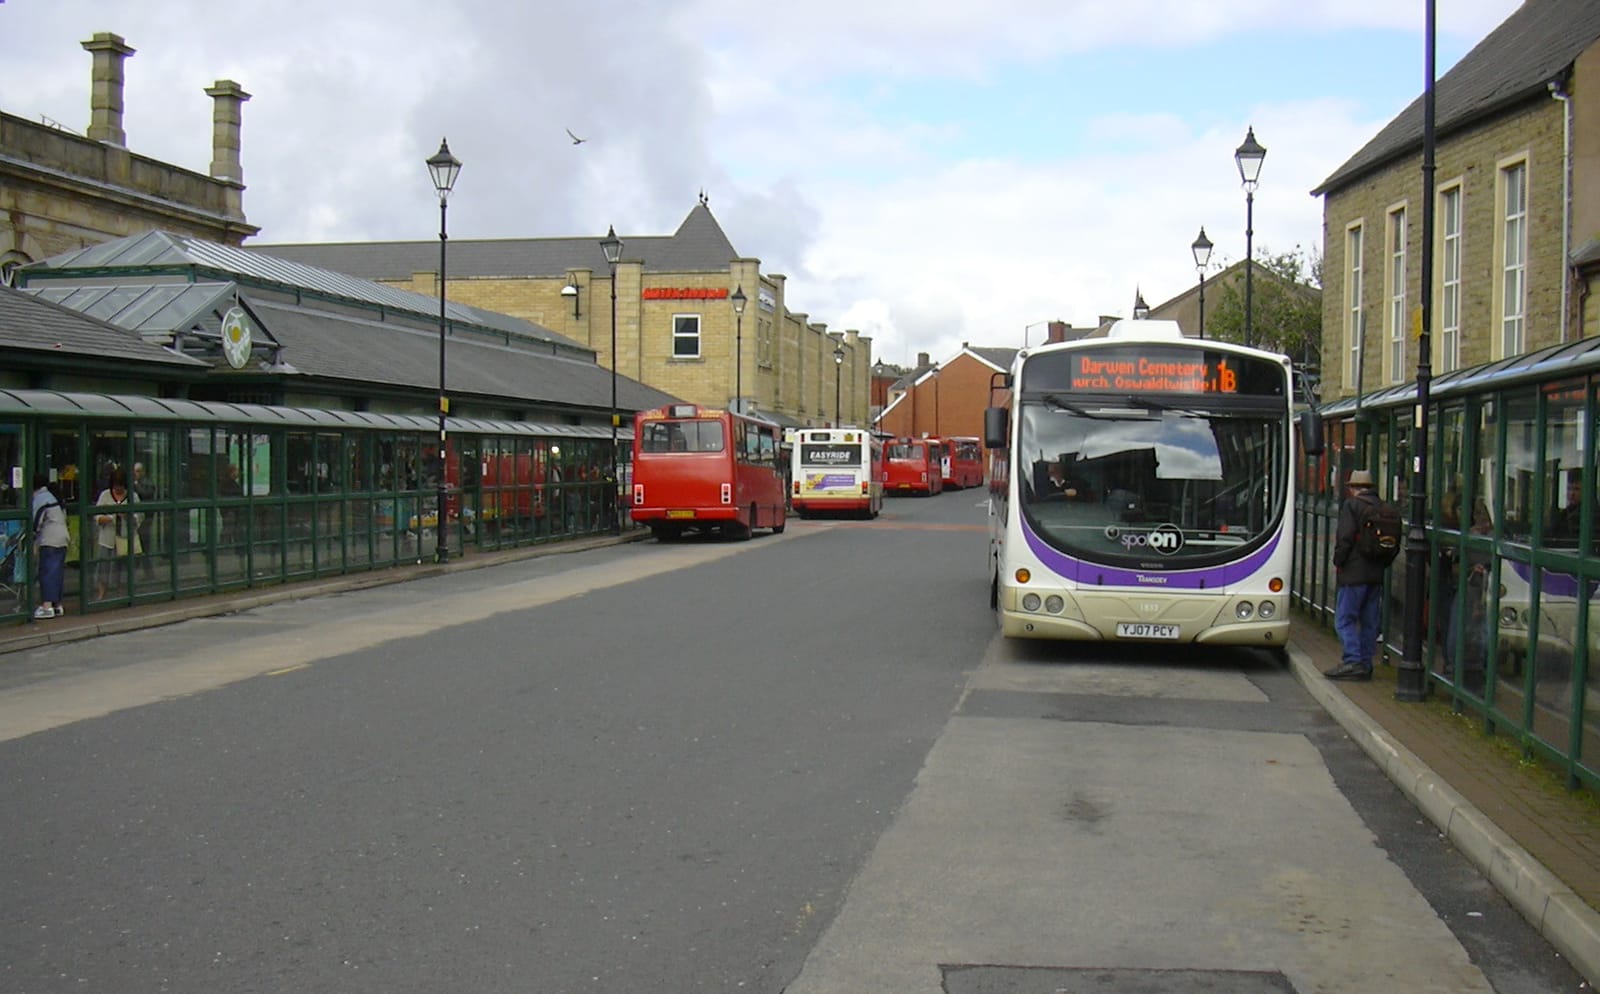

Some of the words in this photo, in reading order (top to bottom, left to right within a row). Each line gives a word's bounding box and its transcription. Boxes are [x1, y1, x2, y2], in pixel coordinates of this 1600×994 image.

[1081, 357, 1134, 374] Darwen
[1139, 358, 1208, 376] Cemetery
[1217, 360, 1237, 392] 1B
[810, 451, 851, 460] EASYRIDE
[1122, 624, 1150, 636] YJ07
[1153, 625, 1175, 637] PCY
